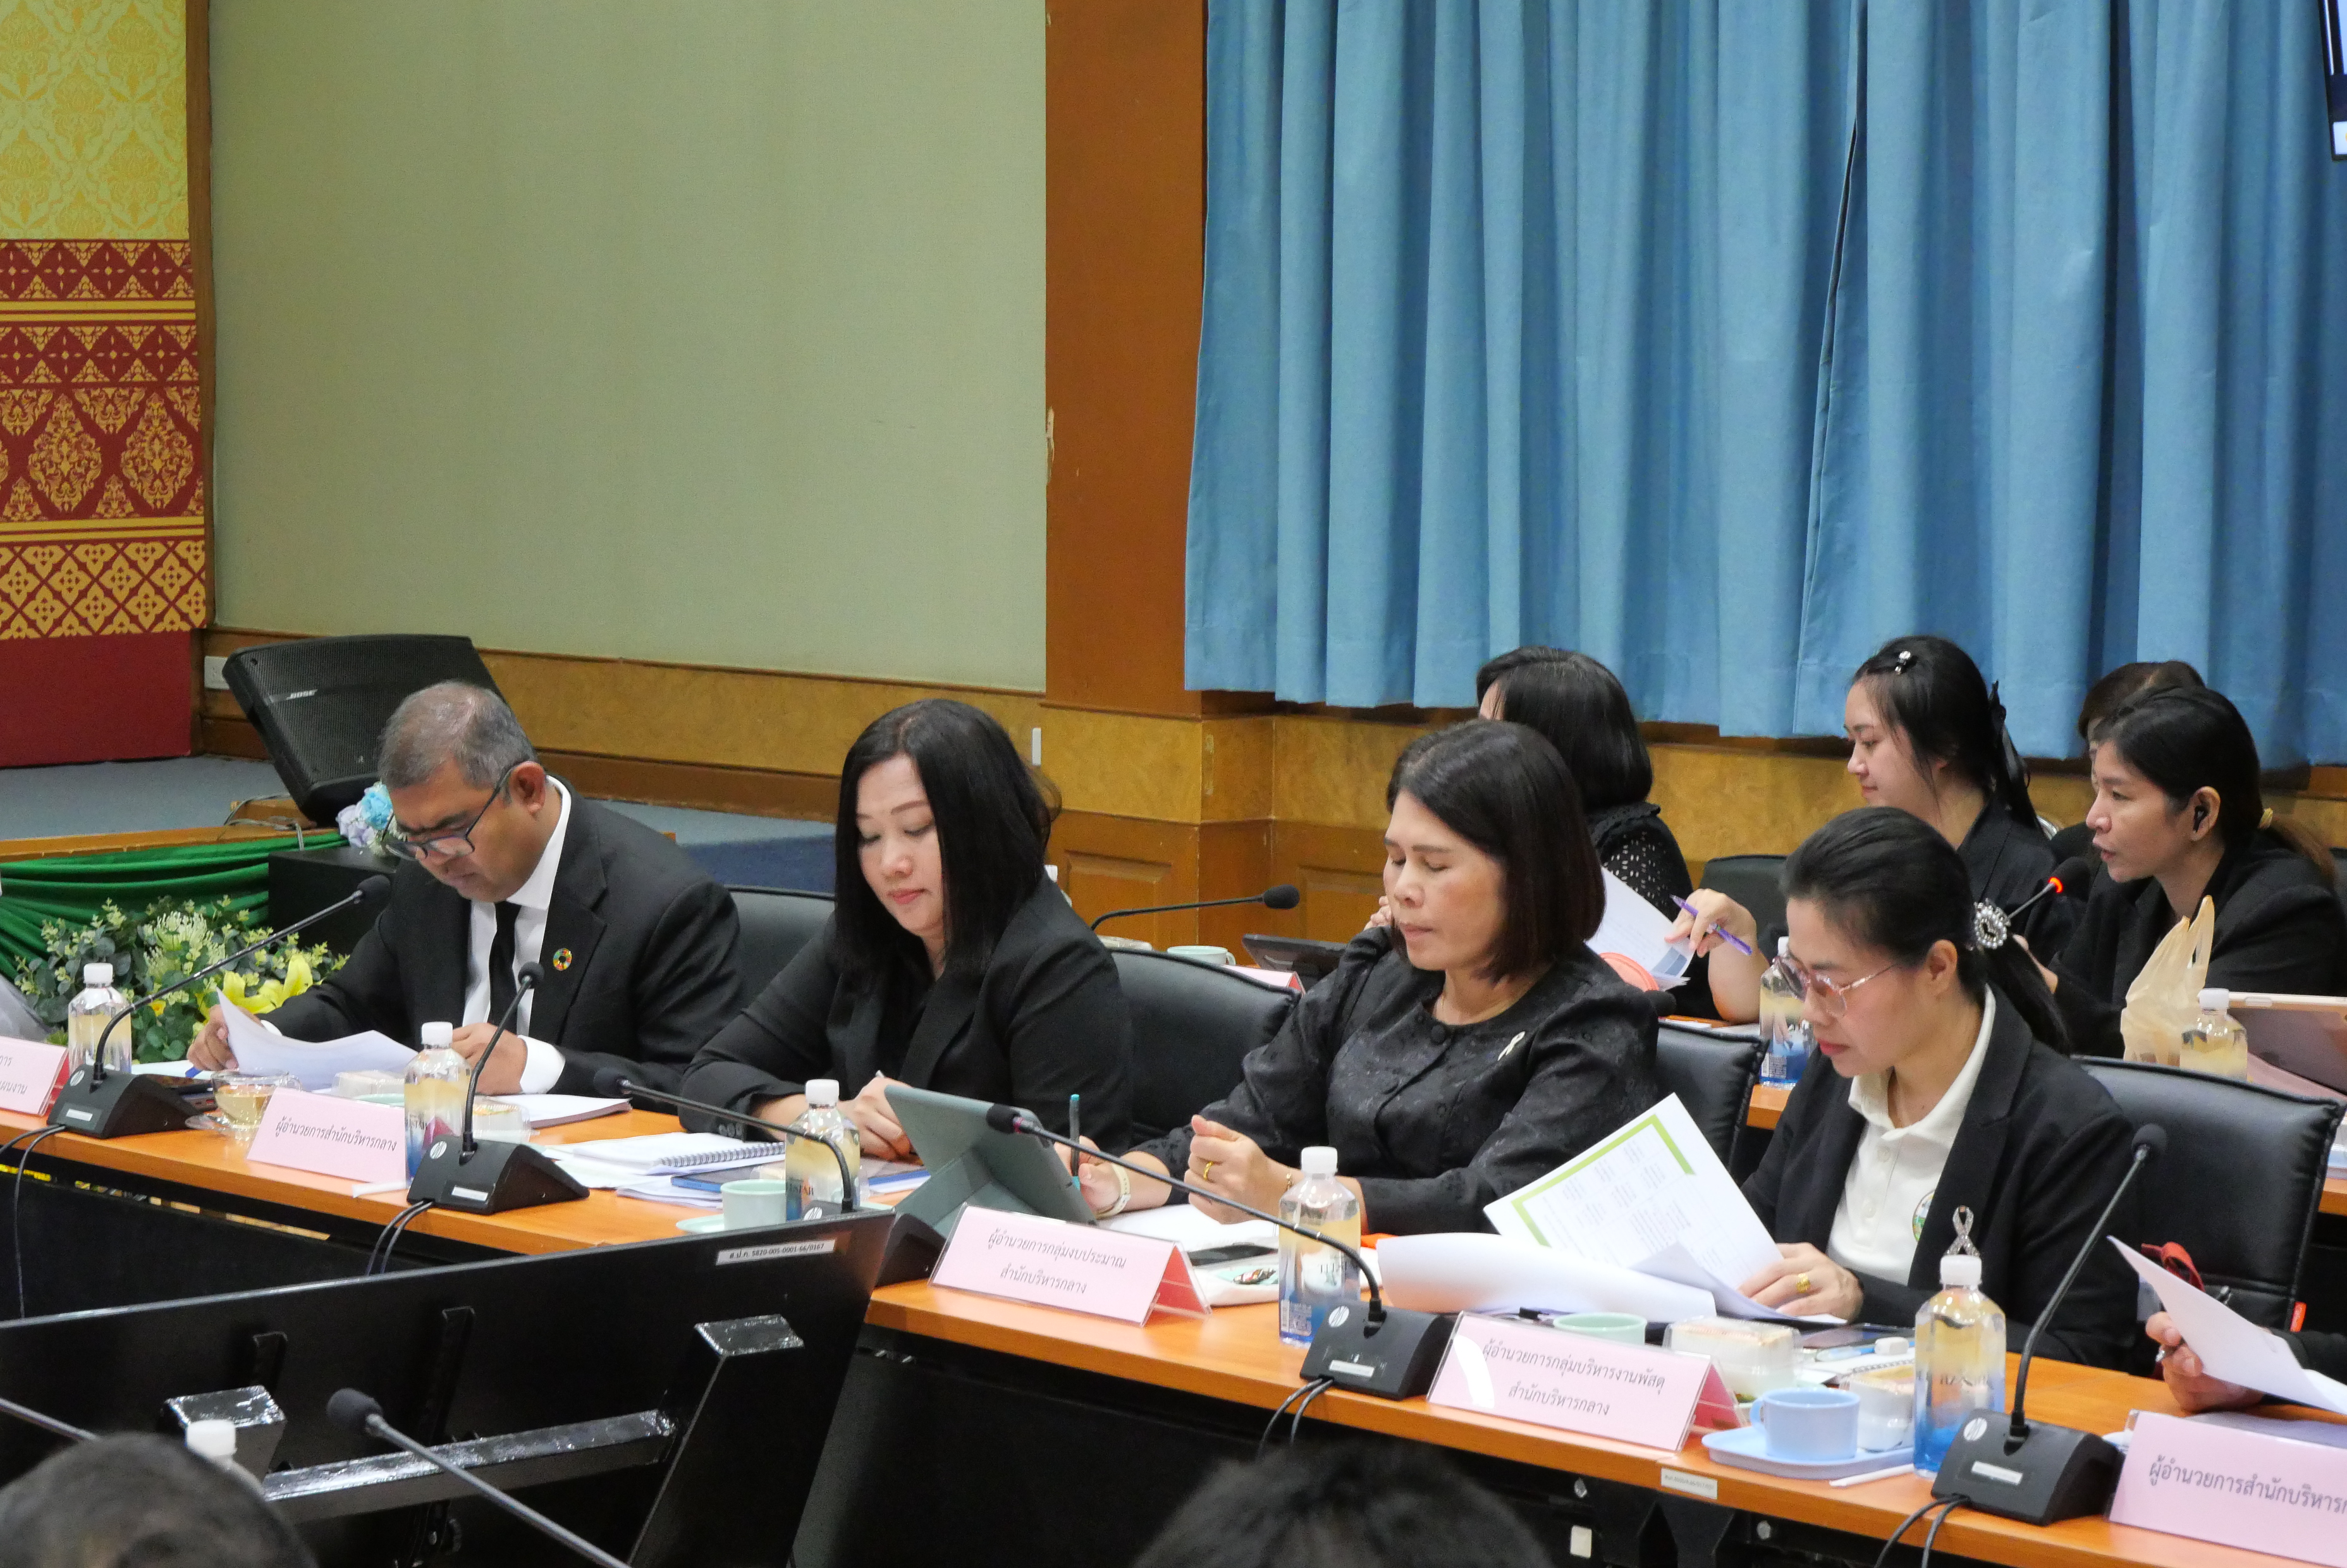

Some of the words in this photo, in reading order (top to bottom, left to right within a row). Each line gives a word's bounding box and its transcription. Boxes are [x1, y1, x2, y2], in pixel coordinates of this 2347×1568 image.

[286, 689, 318, 700] BOSE
[275, 1115, 397, 1152] ผู้อำนวยการสำนักบริหารกลาง
[988, 1228, 1127, 1269] ผู้อำนวยการกลุ่มงบประมาณ
[1000, 1263, 1087, 1295] สำนักบริหารกลาง
[1482, 1337, 1665, 1395] ผู้อำนวยการกลุ่มบริหารงานพัสดุ
[1508, 1380, 1611, 1416] สำนักบริหารกลาง
